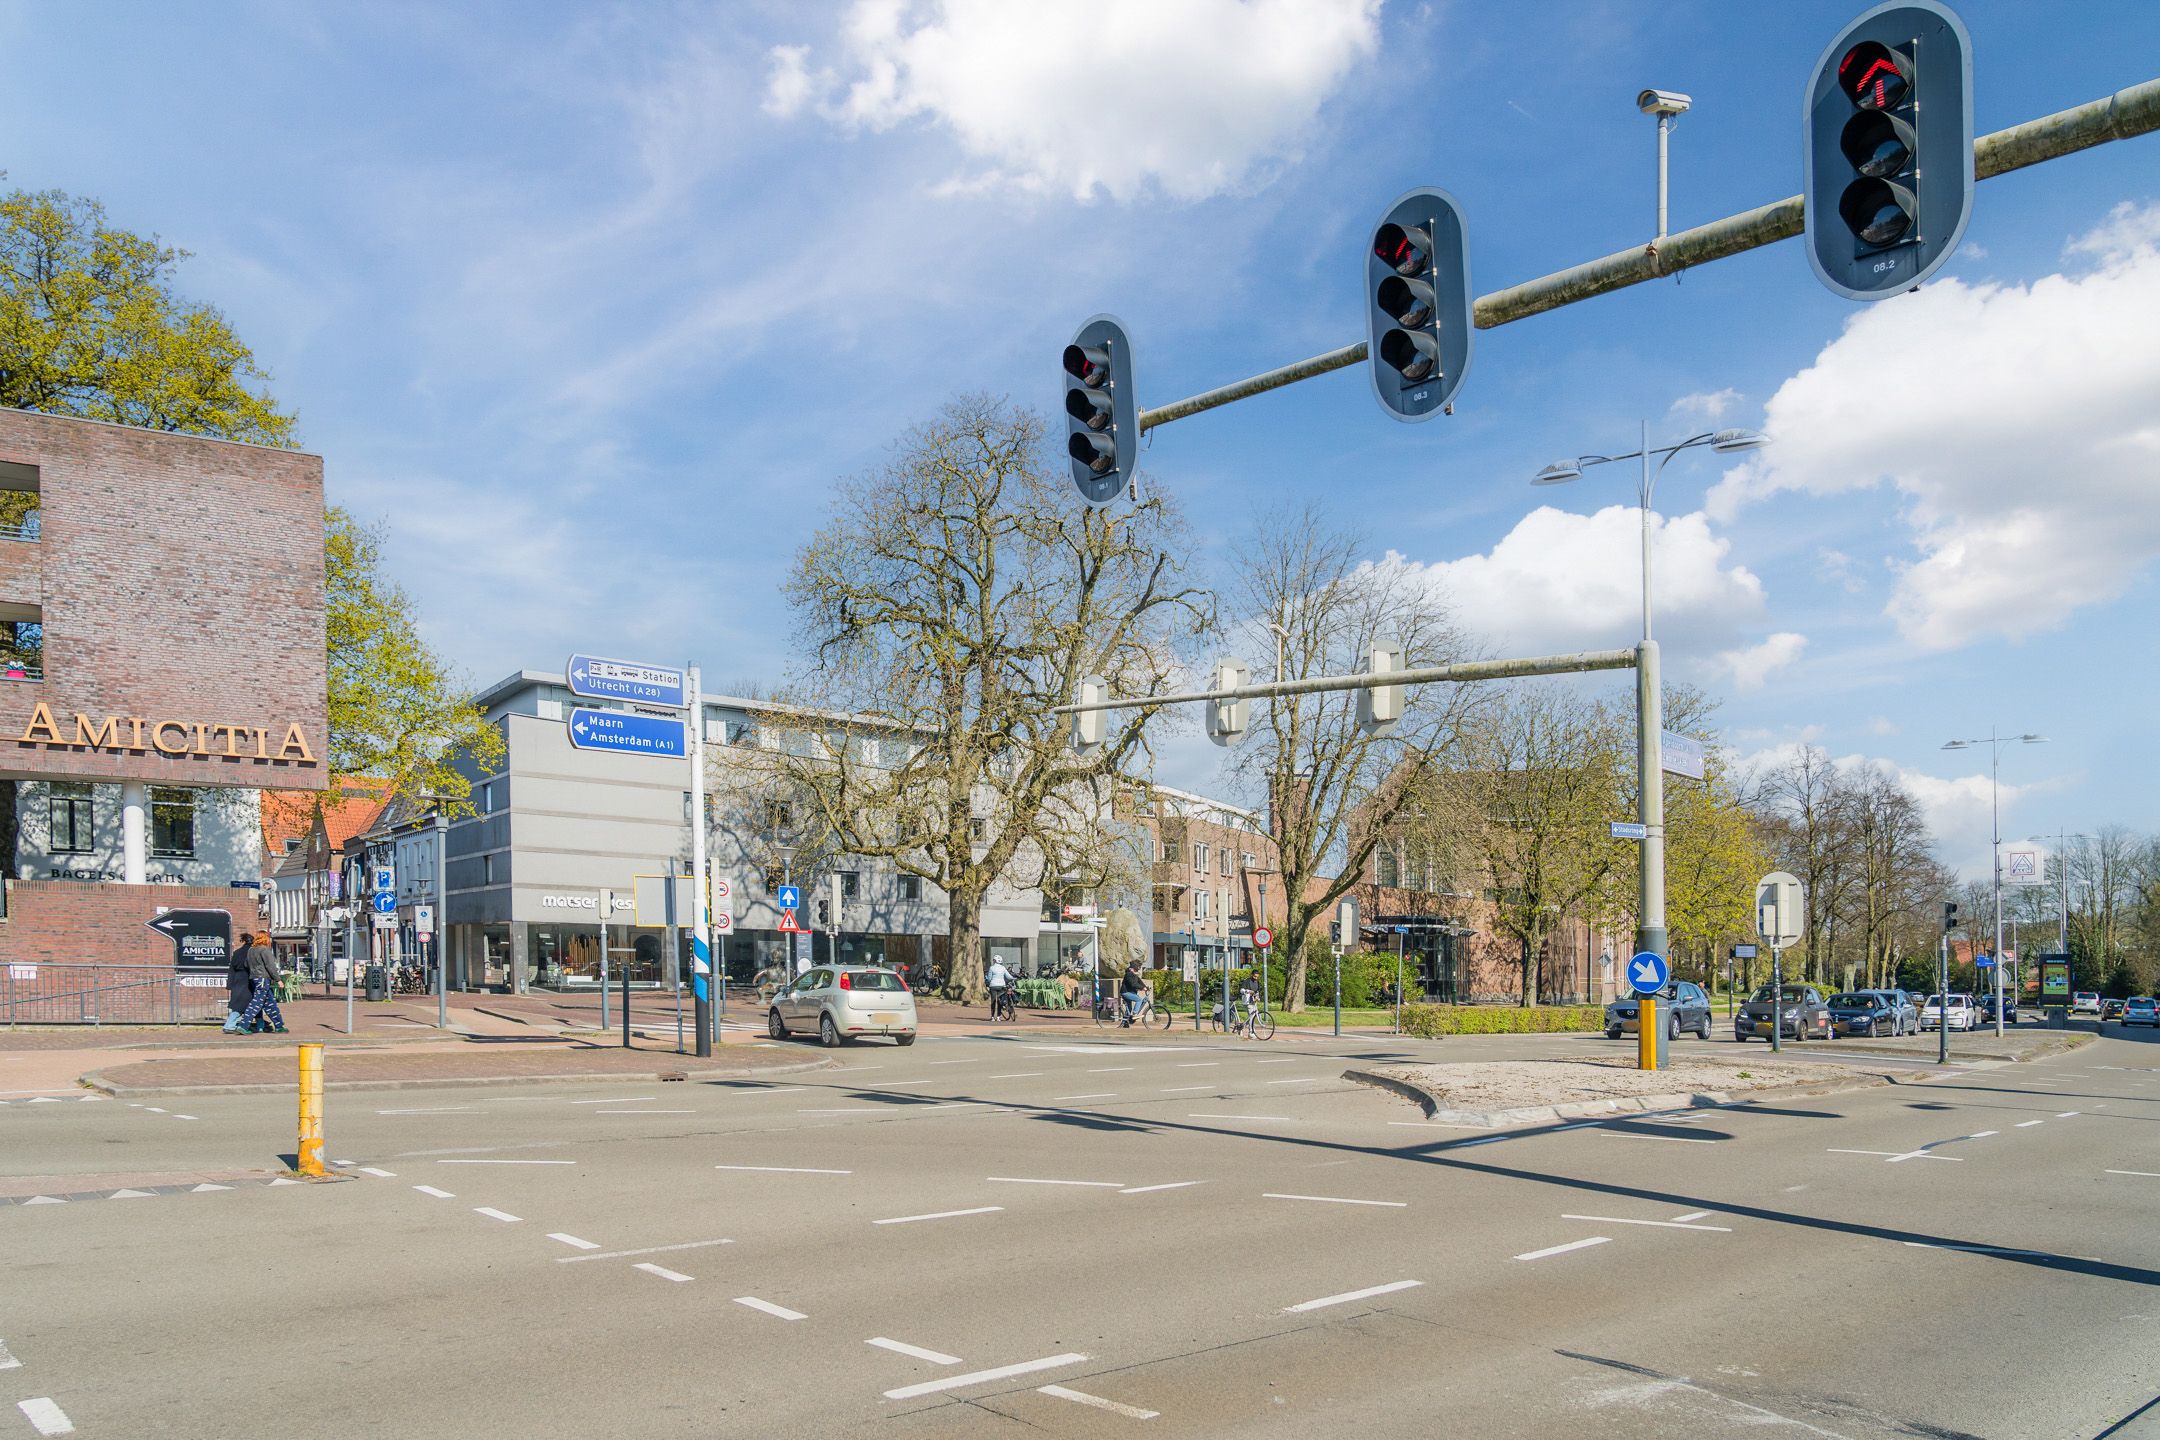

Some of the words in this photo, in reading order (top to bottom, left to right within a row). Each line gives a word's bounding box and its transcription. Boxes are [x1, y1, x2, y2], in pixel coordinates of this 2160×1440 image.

[1873, 260, 1895, 272] 08.2
[642, 671, 679, 684] Station
[588, 678, 630, 695] Utrecht
[633, 686, 661, 697] (A28)
[589, 715, 624, 728] Maarn
[17, 702, 318, 762] AMICITIA
[590, 731, 652, 747] Amsterdam
[655, 739, 674, 750] (A1)
[51, 869, 116, 881] BAGELS
[542, 895, 598, 909] matser
[182, 947, 225, 955] AMICITIA
